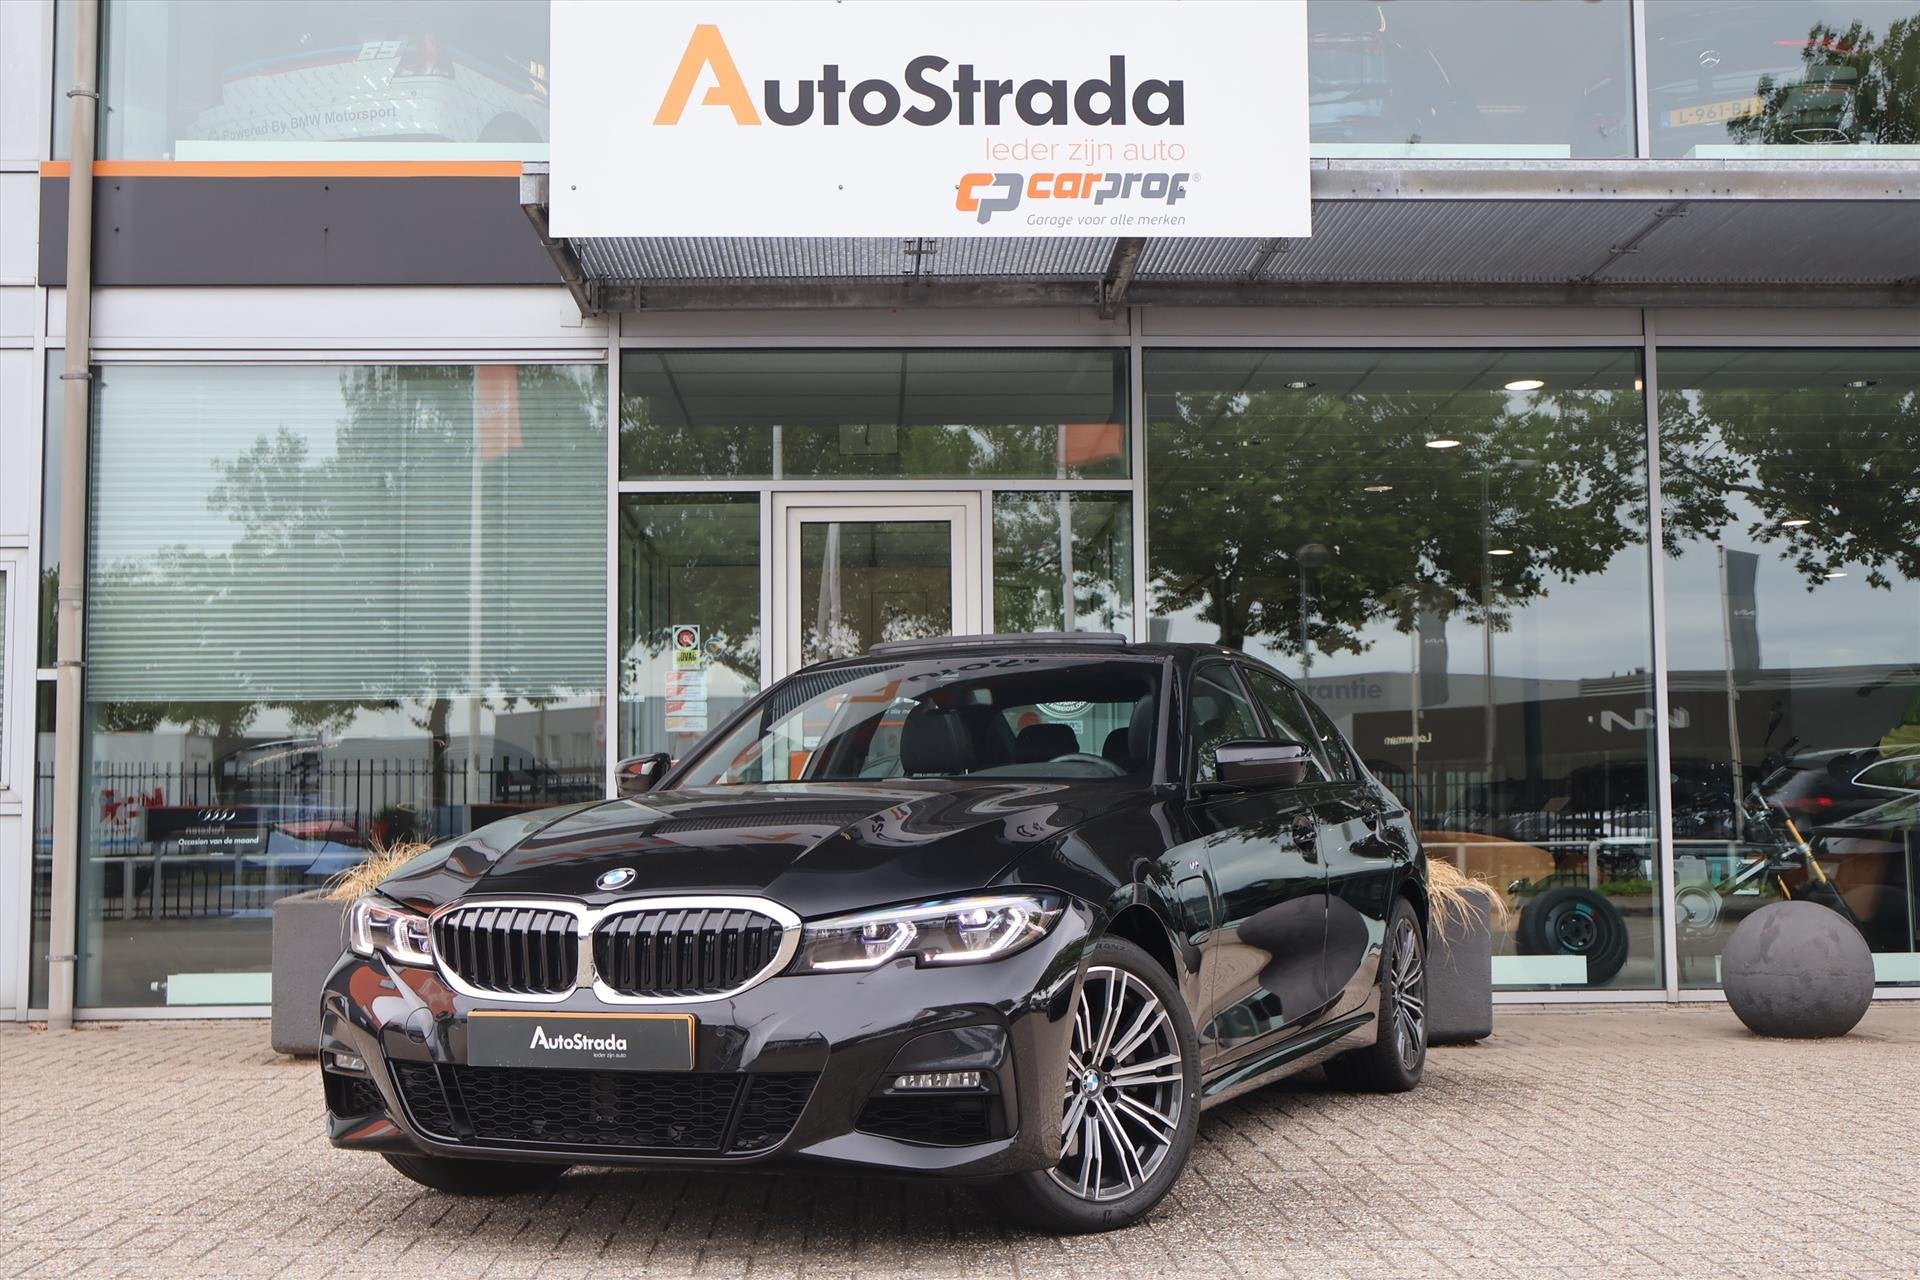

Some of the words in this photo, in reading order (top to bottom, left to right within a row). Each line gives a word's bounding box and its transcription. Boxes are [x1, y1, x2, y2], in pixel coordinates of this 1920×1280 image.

[653, 24, 1186, 127] AutoStrada
[222, 123, 269, 141] Powered
[271, 120, 286, 134] By
[290, 113, 321, 130] BMW
[324, 105, 397, 125] Motorsport
[985, 137, 1059, 161] Ieder
[1068, 138, 1113, 166] zijn
[1123, 139, 1185, 161] auto
[1026, 214, 1073, 228] Garage
[1077, 216, 1106, 226] voor
[1110, 214, 1135, 226] alle
[1138, 214, 1186, 226] merken
[178, 838, 208, 846] Occasion
[223, 836, 233, 845] de
[234, 835, 259, 845] maand
[529, 1025, 628, 1050] AutoStrada
